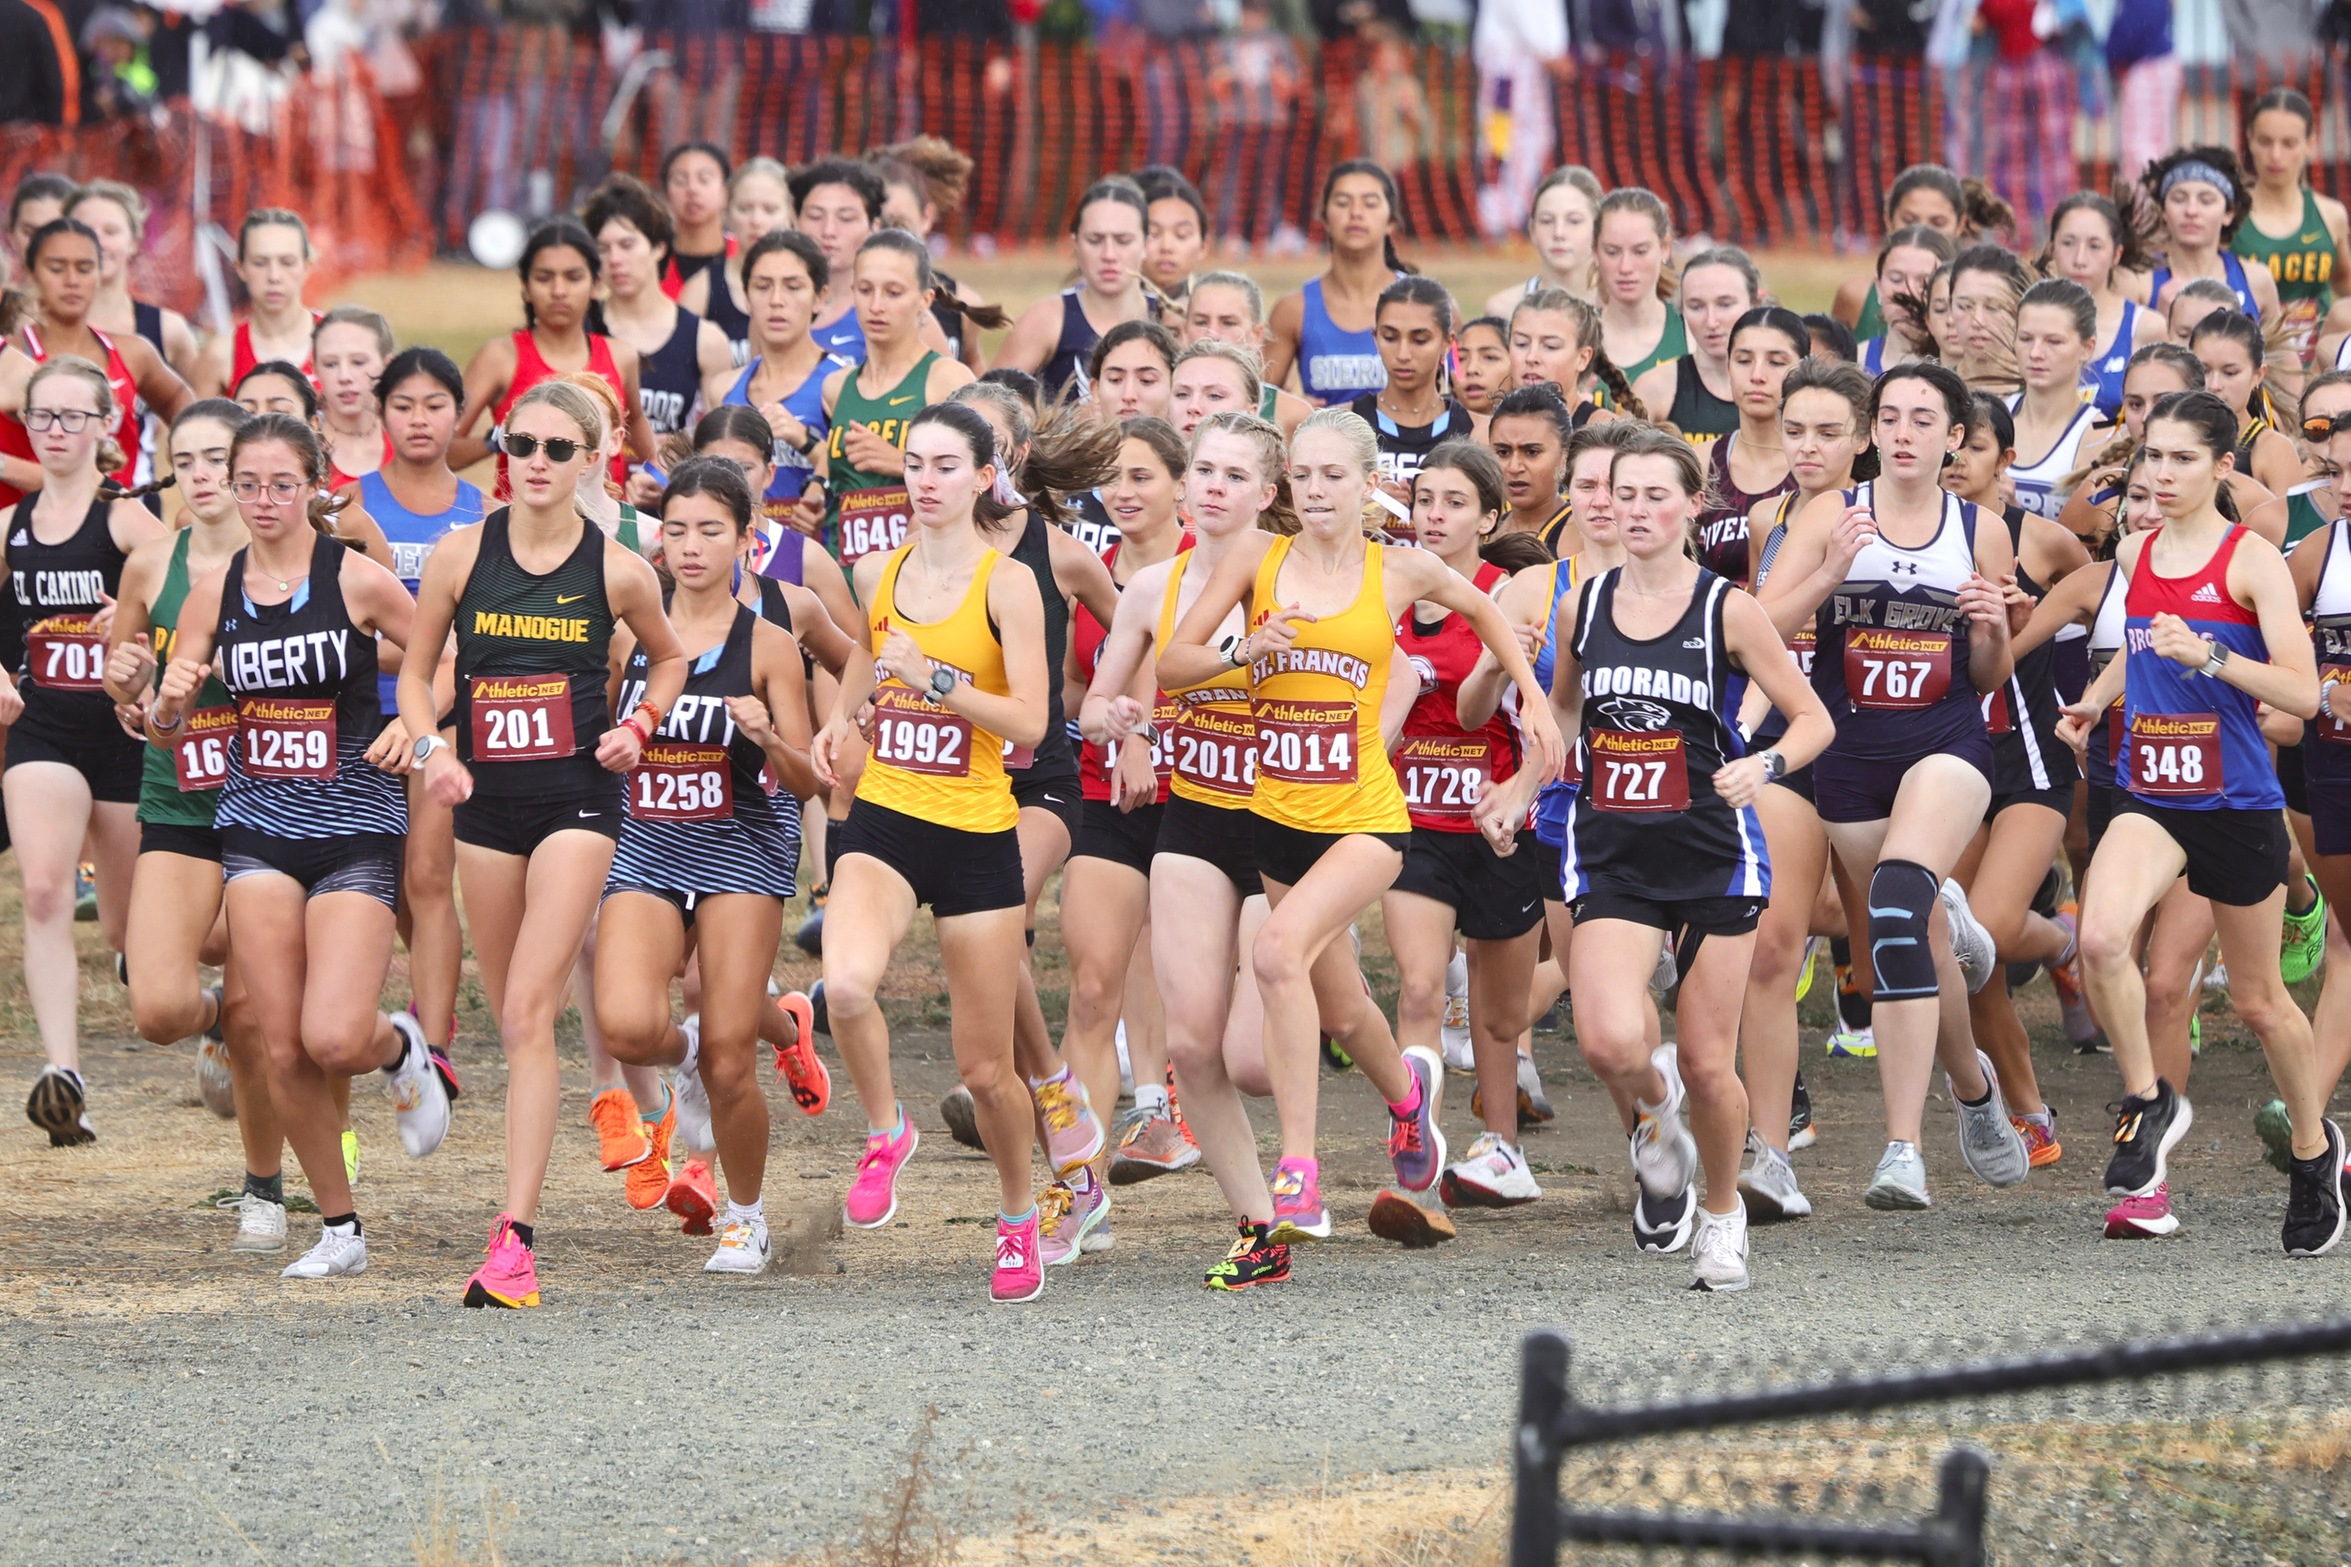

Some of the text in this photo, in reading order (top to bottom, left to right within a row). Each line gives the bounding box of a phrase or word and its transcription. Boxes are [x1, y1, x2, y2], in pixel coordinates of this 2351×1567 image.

[843, 513, 908, 556] 1646
[36, 570, 105, 606] CAMINO
[473, 611, 590, 642] MANOGUE
[1833, 595, 1876, 624] ELK
[45, 642, 104, 680] 701
[217, 629, 348, 692] LIBERTY
[1276, 648, 1371, 690] FRANCIS
[1862, 660, 1932, 698] 767
[1593, 666, 1709, 711] DORADO
[485, 708, 554, 749] 201
[876, 719, 963, 765] 1992
[247, 728, 328, 770] 1259
[1178, 736, 1259, 785] 2018
[1260, 729, 1352, 772] 2014
[2140, 745, 2204, 783] 348
[638, 771, 724, 811] 1258
[1405, 766, 1482, 805] 1728
[1605, 761, 1667, 800] 727
